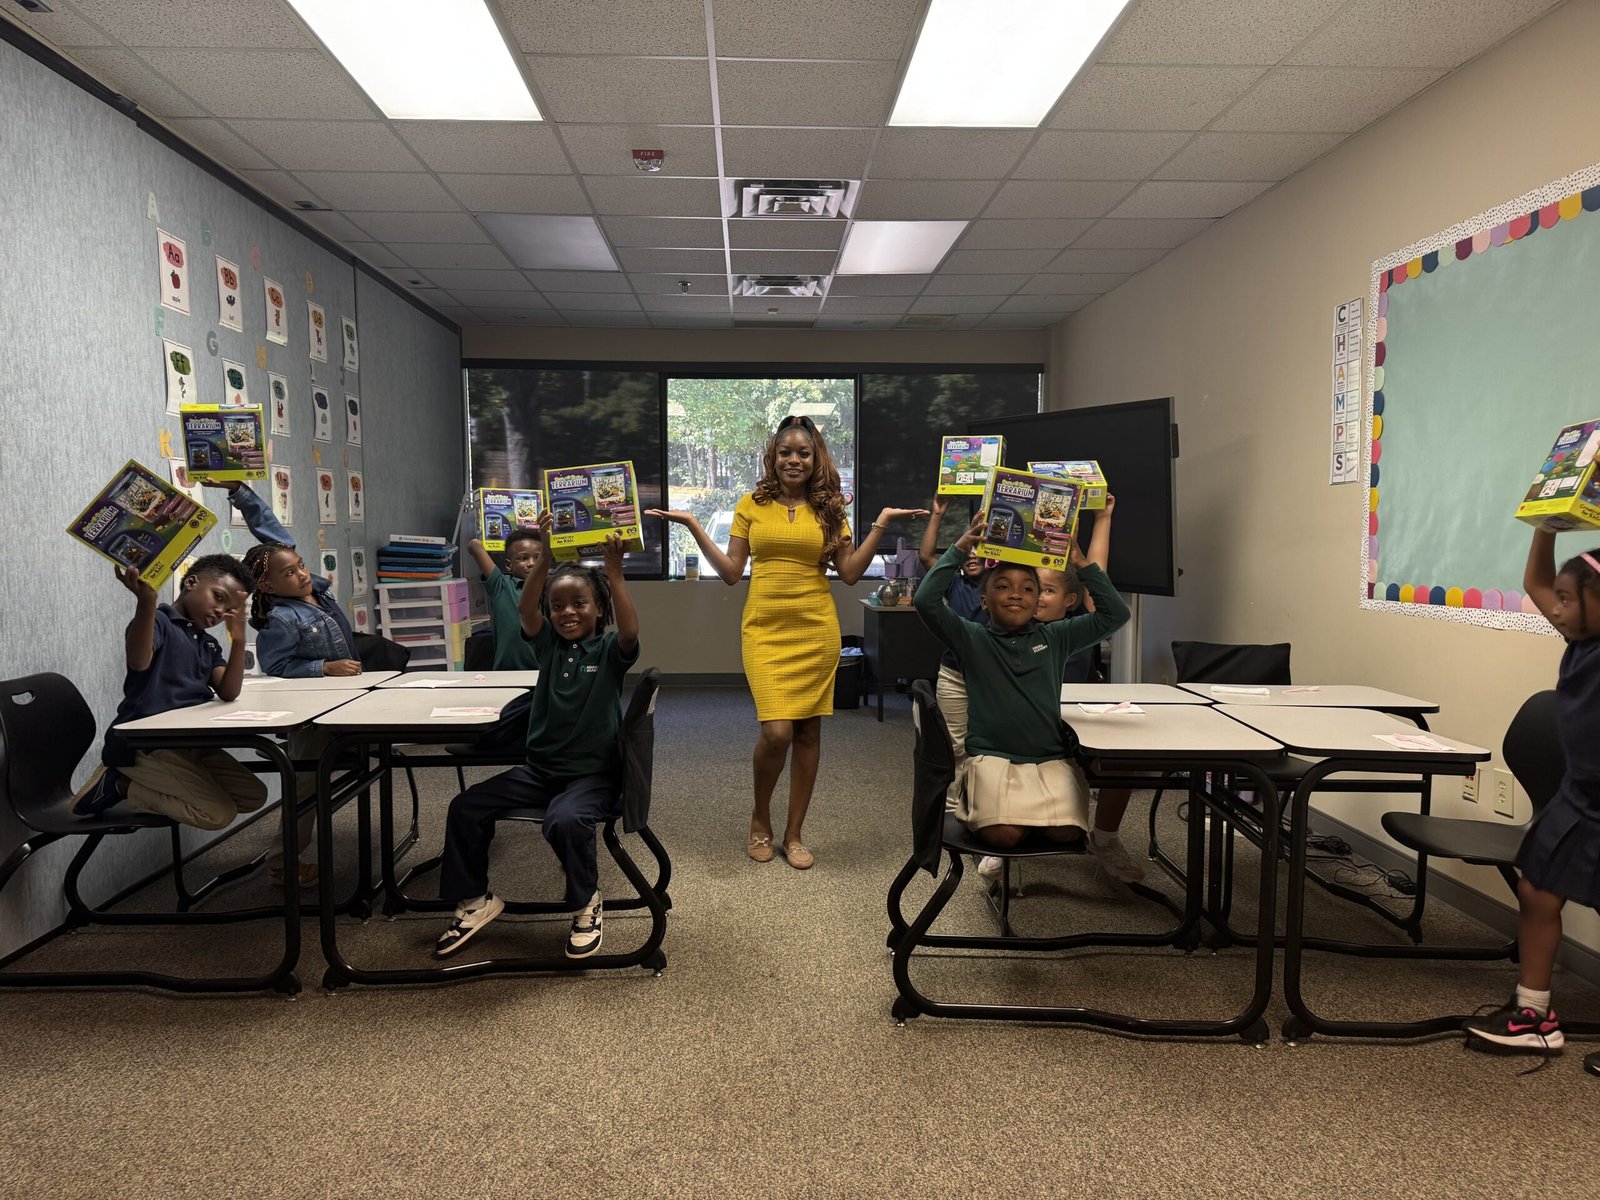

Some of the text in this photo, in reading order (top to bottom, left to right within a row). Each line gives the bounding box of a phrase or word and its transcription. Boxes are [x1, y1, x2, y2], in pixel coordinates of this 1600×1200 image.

[146, 191, 161, 224] A
[168, 245, 180, 264] Aa
[224, 268, 235, 286] Bb
[207, 331, 219, 357] G
[159, 428, 174, 459] K
[552, 479, 588, 490] TERRARIUM
[998, 484, 1035, 498] TERRARIUM
[85, 507, 118, 541] TERRARIUM
